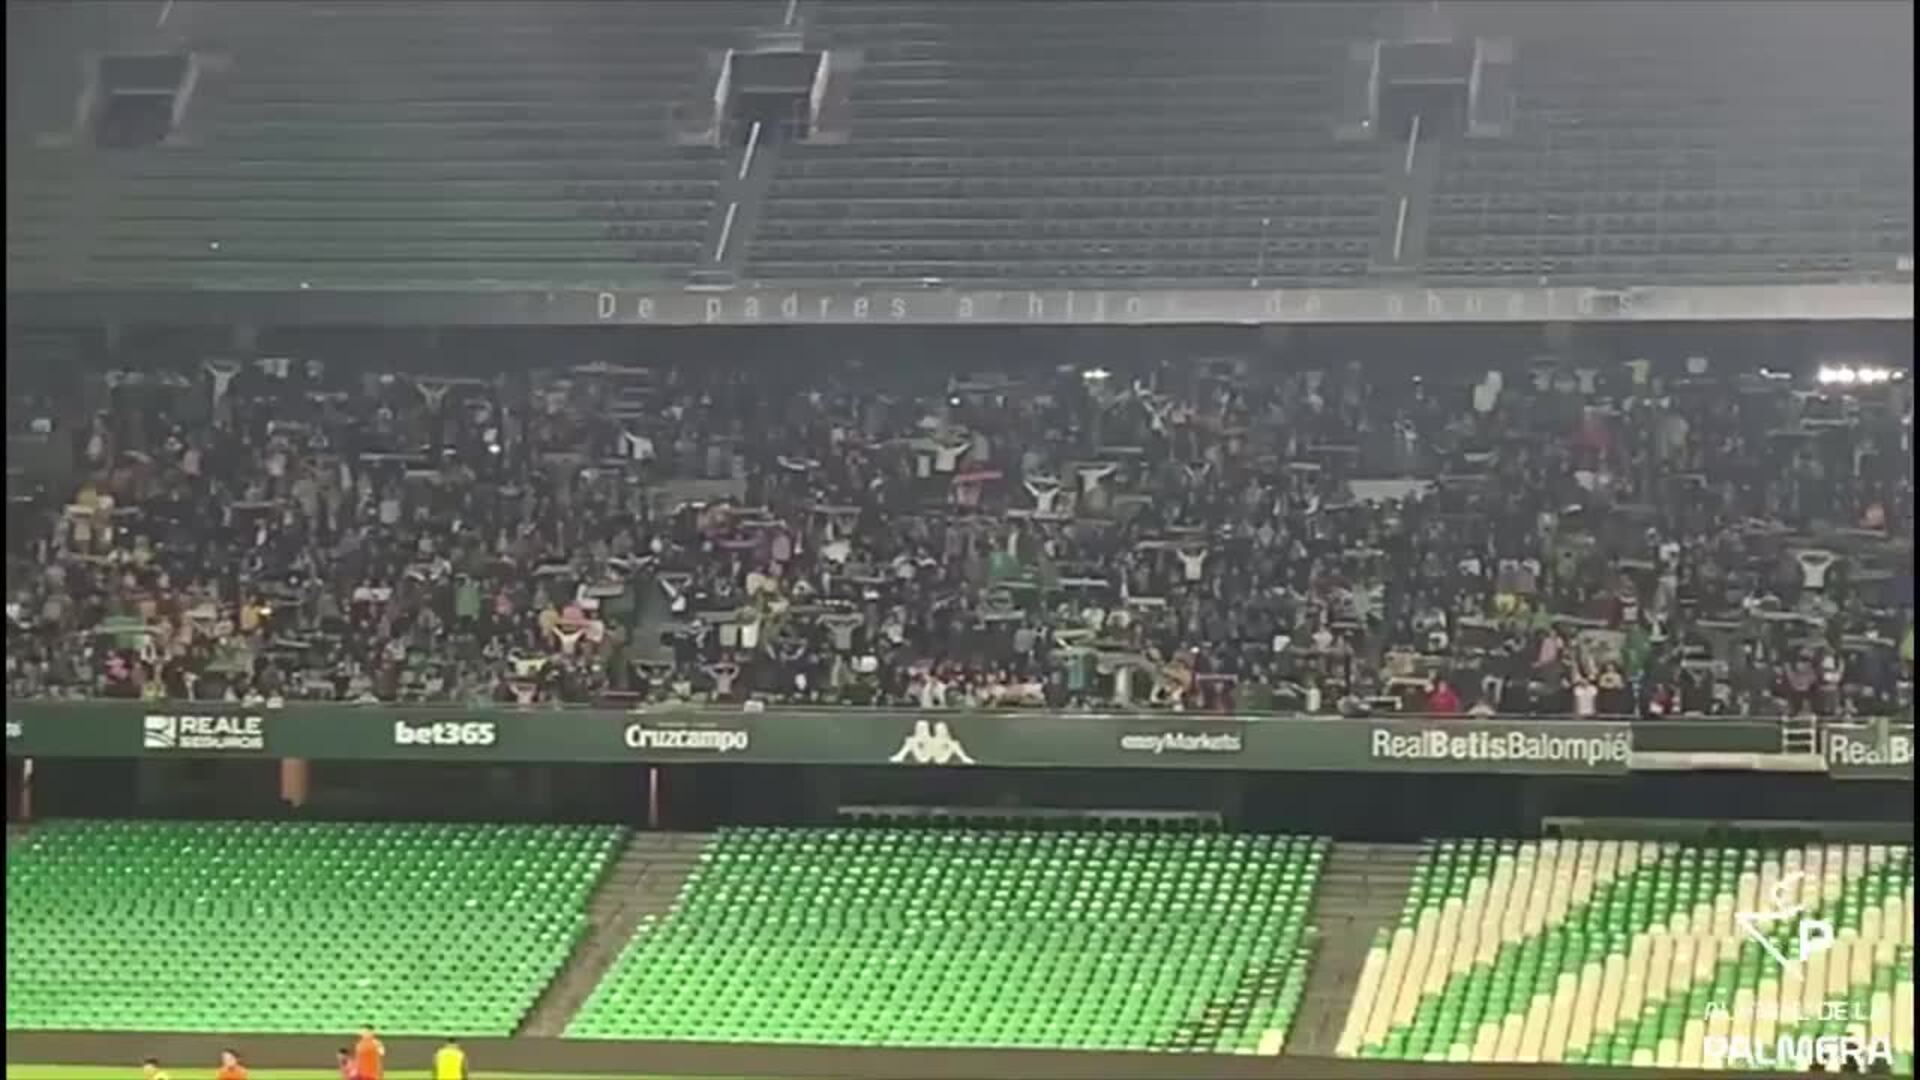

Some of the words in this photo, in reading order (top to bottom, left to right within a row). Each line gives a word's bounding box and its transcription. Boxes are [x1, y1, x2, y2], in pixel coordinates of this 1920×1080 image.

[597, 292, 655, 319] De
[705, 290, 907, 322] padres
[959, 296, 974, 318] a
[1028, 290, 1178, 322] hijo
[180, 716, 262, 734] REALE
[395, 721, 495, 745] bet365
[625, 724, 748, 752] Cruzcampo
[1121, 732, 1241, 754] easyMarkets
